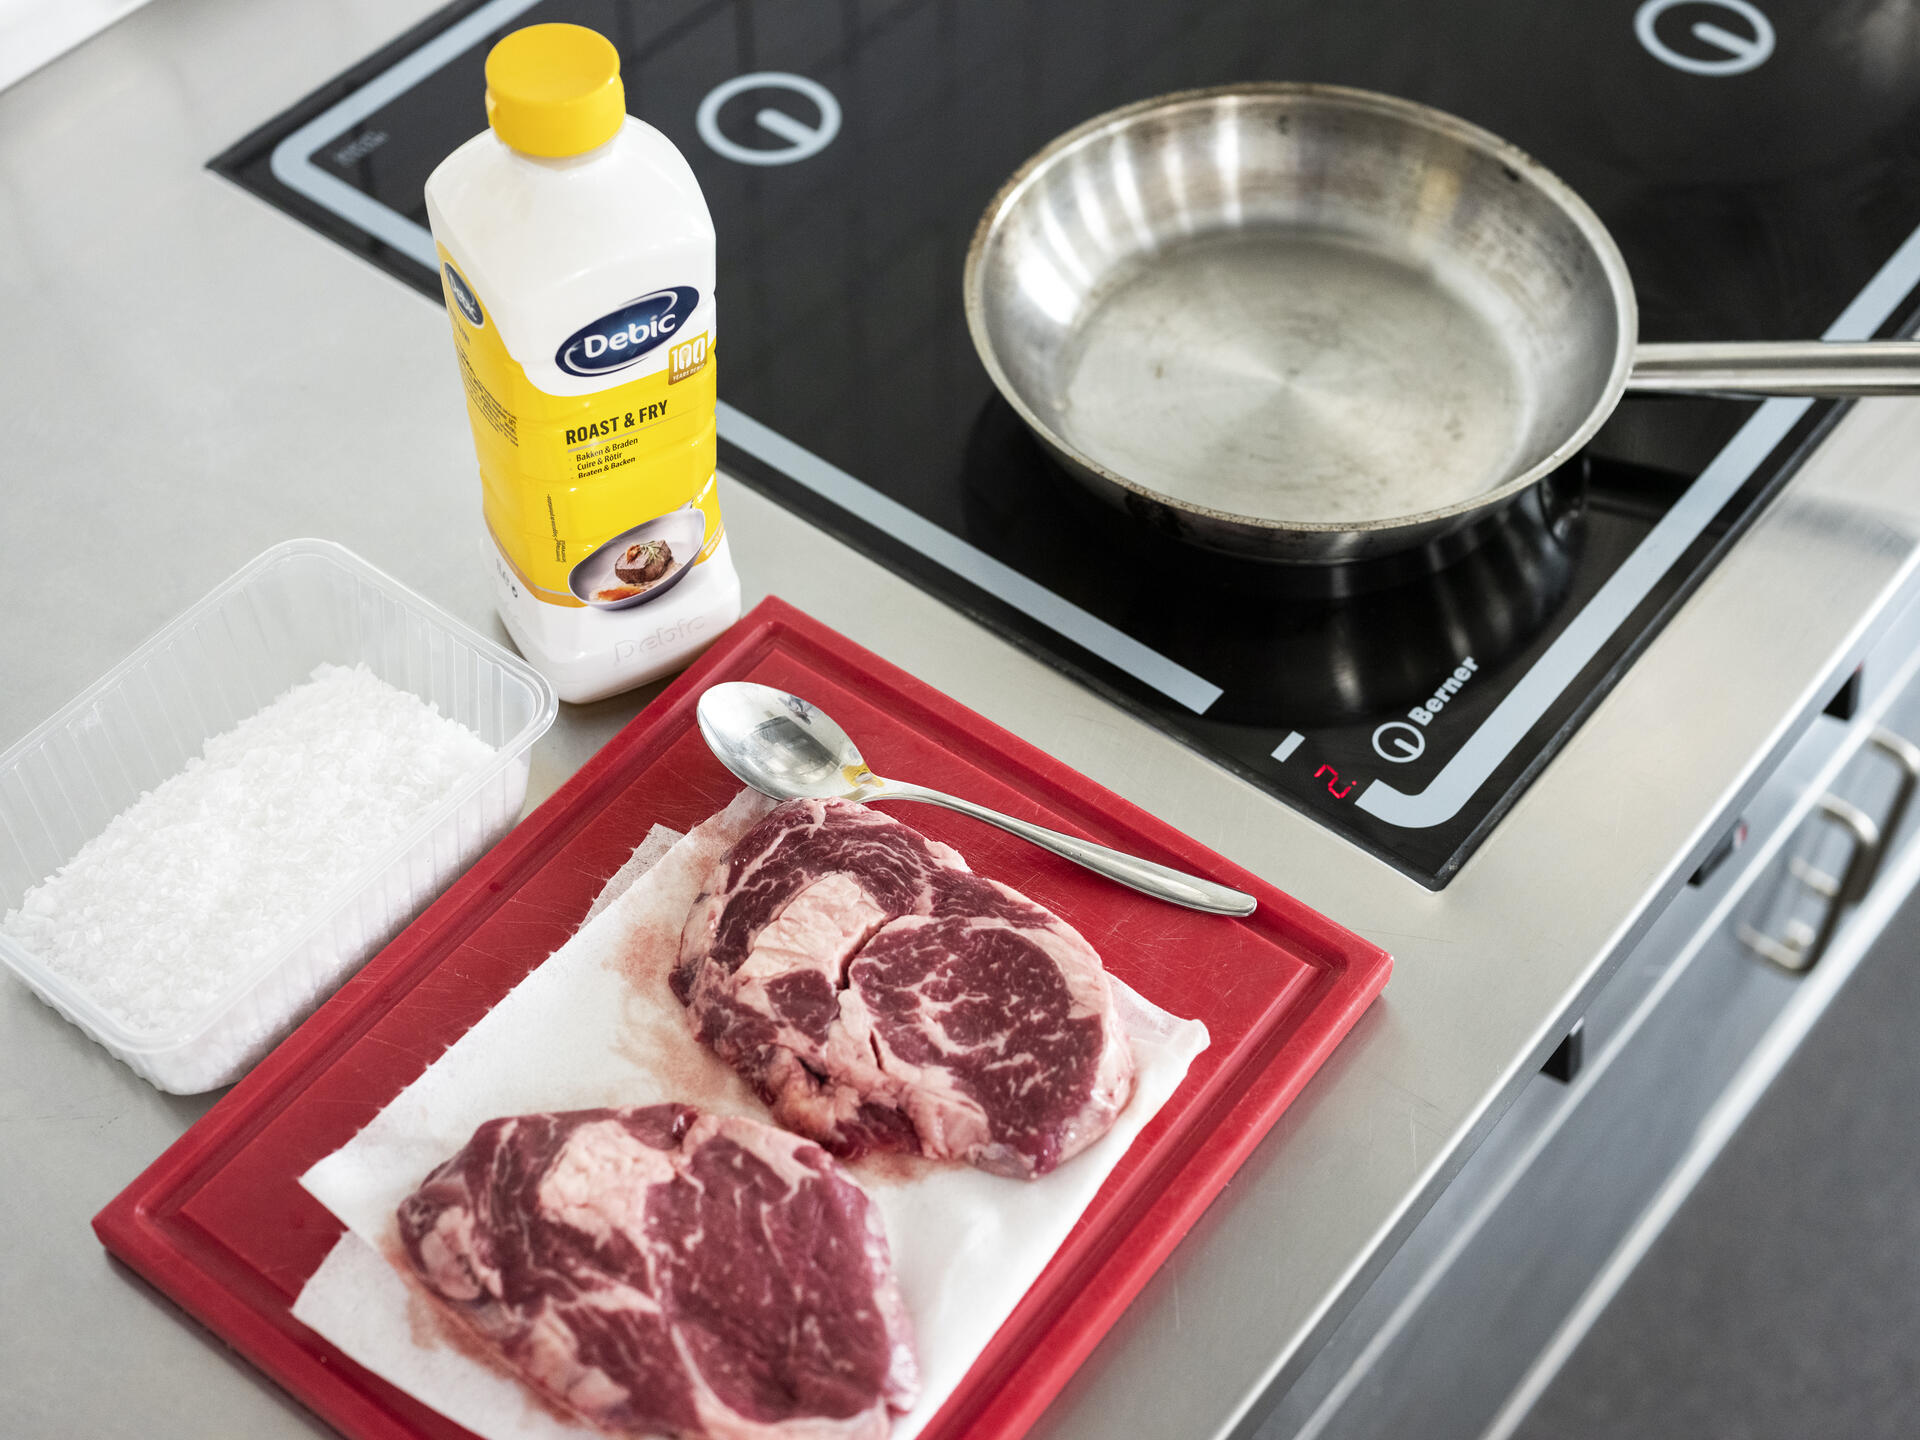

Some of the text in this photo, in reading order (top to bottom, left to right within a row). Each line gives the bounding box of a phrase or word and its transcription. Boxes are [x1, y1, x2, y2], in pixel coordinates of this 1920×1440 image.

[584, 313, 676, 359] Debic
[671, 337, 706, 373] 100
[565, 399, 668, 446] ROAST & FRY
[576, 437, 639, 462] Bakken & Braden
[577, 451, 623, 471] Cuire & Rôtir
[578, 456, 636, 479] Braten & Backen
[1407, 656, 1479, 727] Berner
